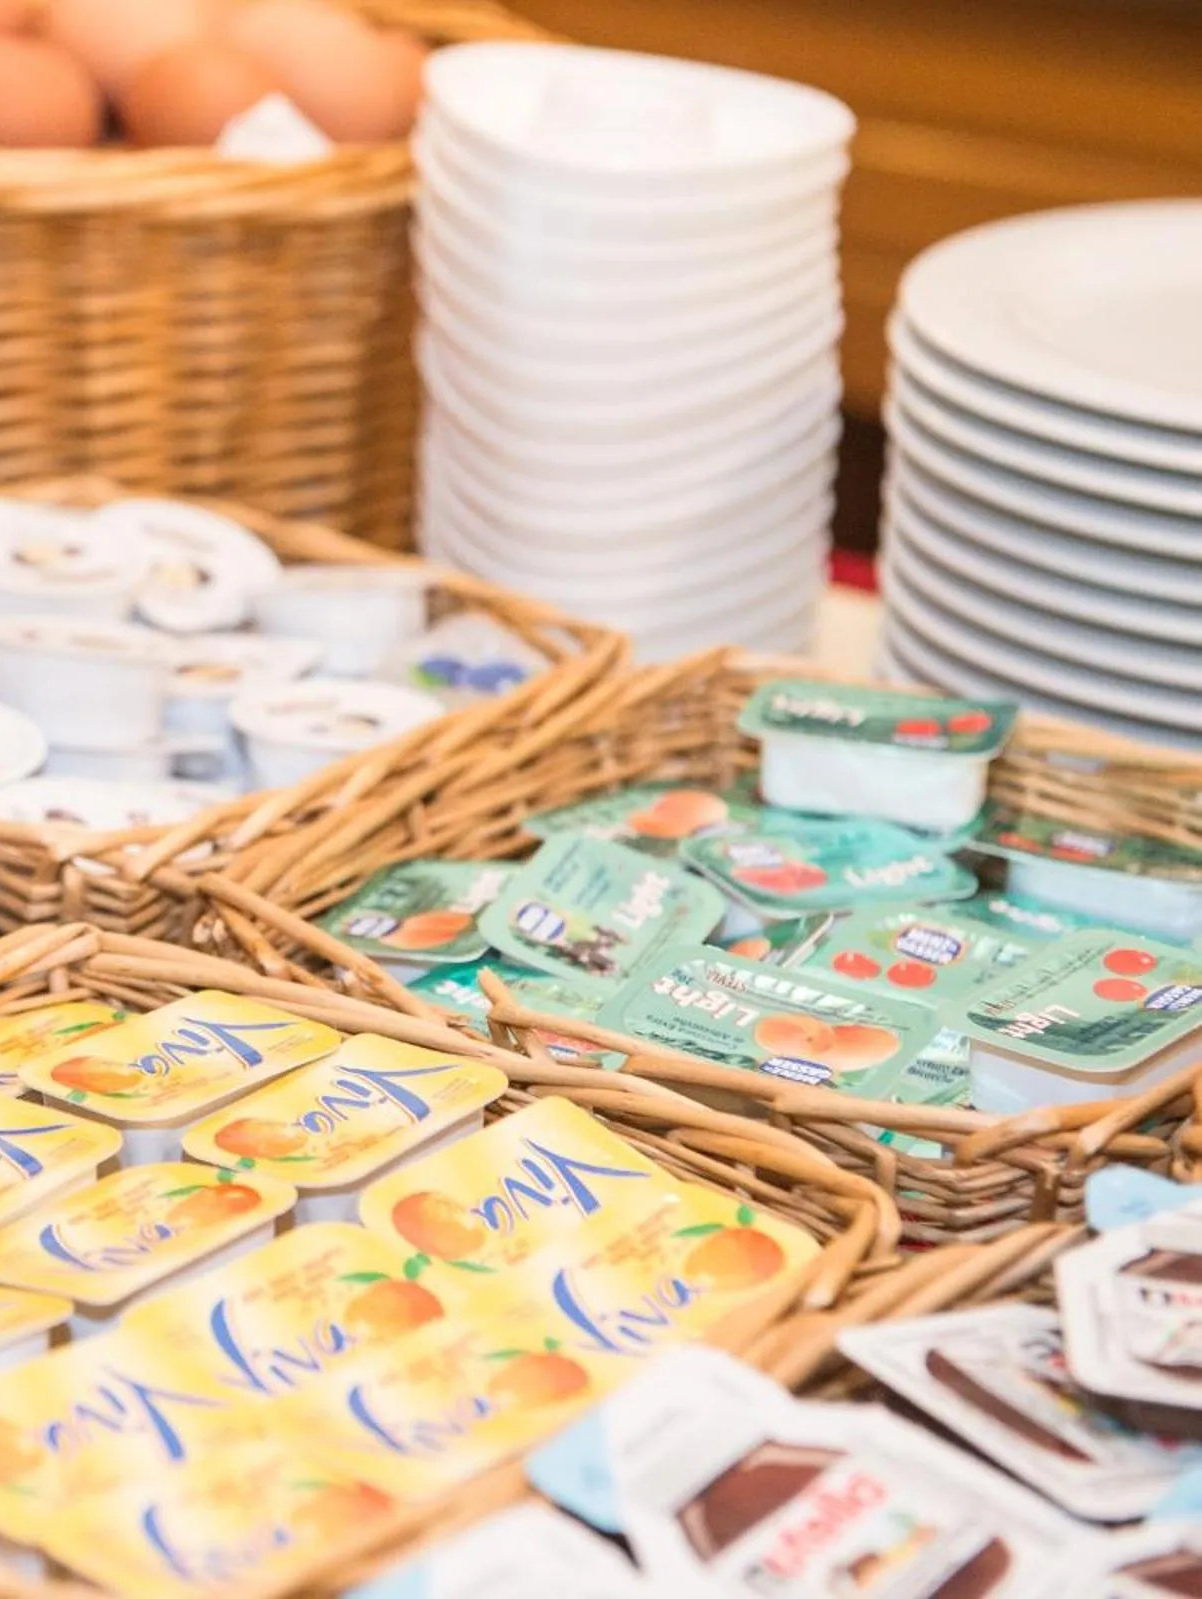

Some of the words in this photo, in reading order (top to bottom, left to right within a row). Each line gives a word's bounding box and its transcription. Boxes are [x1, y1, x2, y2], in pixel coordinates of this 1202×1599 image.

[652, 976, 760, 1028] Light
[998, 1004, 1081, 1040] Light
[129, 1016, 299, 1077] Viva
[294, 1064, 463, 1126] Viva
[470, 1137, 653, 1236] Viva
[39, 1223, 184, 1272] Viva
[552, 1267, 705, 1356] Viva
[210, 1297, 358, 1395] Viva
[42, 1364, 238, 1464] Viva
